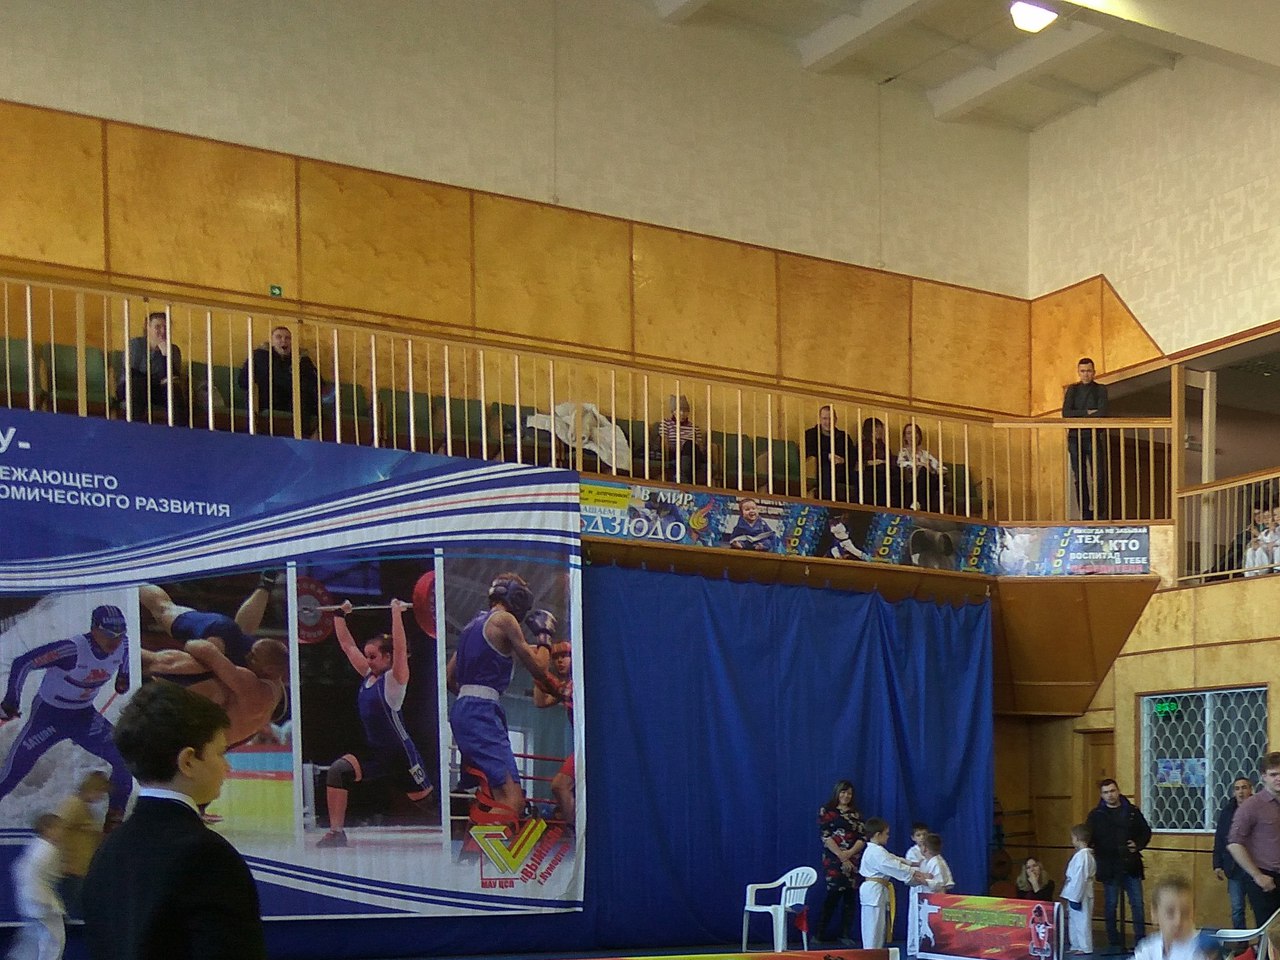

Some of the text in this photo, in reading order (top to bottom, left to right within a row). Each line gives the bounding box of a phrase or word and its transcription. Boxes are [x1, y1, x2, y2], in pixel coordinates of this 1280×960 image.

[0, 465, 119, 491] ЕЖАЮЩЕГО
[135, 496, 231, 518] РАЗВИТИЯ
[587, 515, 687, 542] ДЗЮДО
[790, 506, 810, 548] JUDO
[879, 516, 900, 556] JUDO
[969, 527, 988, 566] JUDO
[1053, 527, 1074, 568] JUDO
[1109, 539, 1140, 551] КТО
